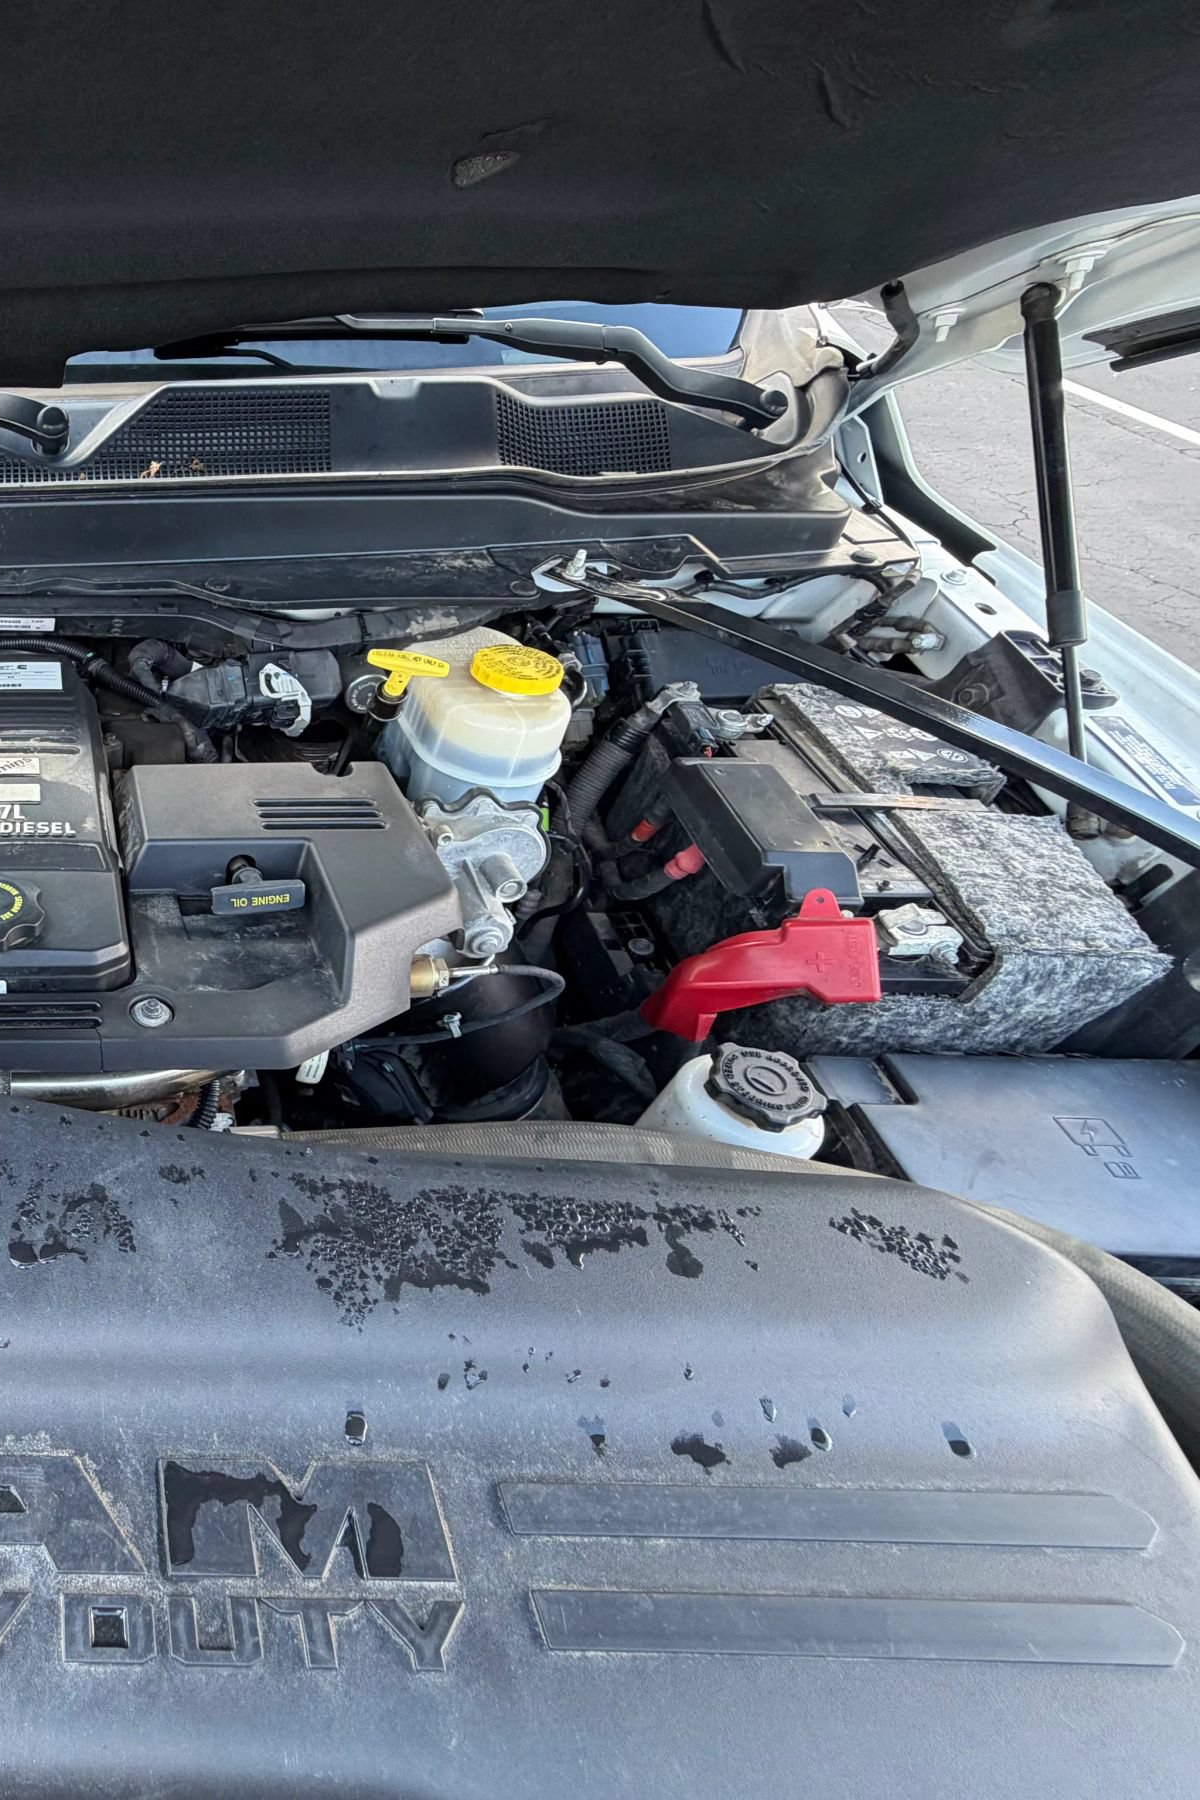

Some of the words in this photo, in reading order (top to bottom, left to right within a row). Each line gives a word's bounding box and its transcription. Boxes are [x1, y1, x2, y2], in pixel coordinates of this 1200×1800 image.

[0, 822, 77, 837] DIESEL
[230, 897, 248, 908] OIL
[251, 893, 291, 907] ENGINE
[57, 1590, 467, 1671] DUTY
